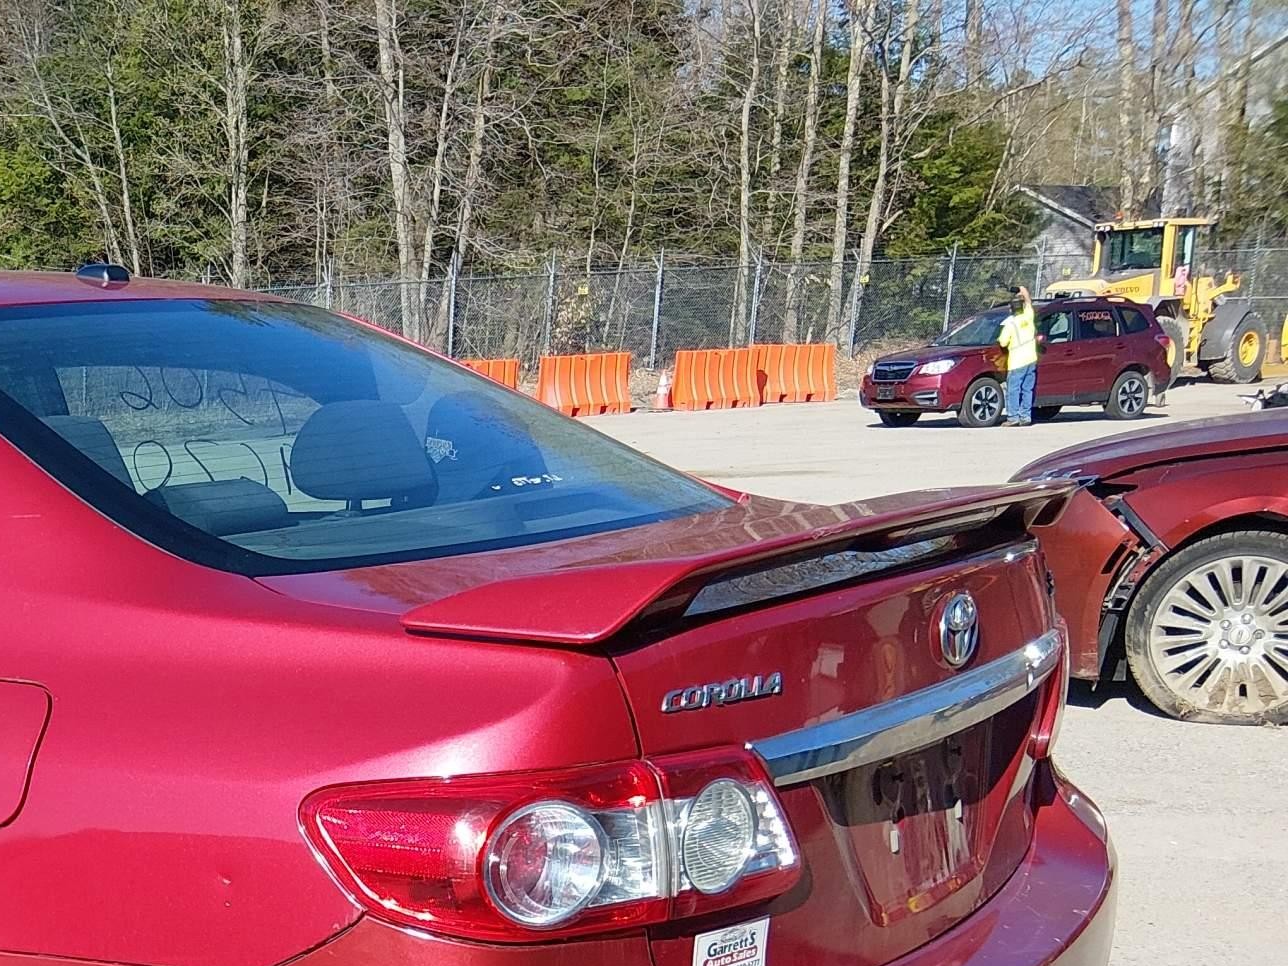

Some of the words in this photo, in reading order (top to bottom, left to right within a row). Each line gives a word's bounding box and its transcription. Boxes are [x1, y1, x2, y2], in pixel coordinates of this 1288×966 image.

[1114, 286, 1140, 294] VOLVO
[660, 672, 782, 713] COROLLA
[732, 947, 757, 961] Sales
